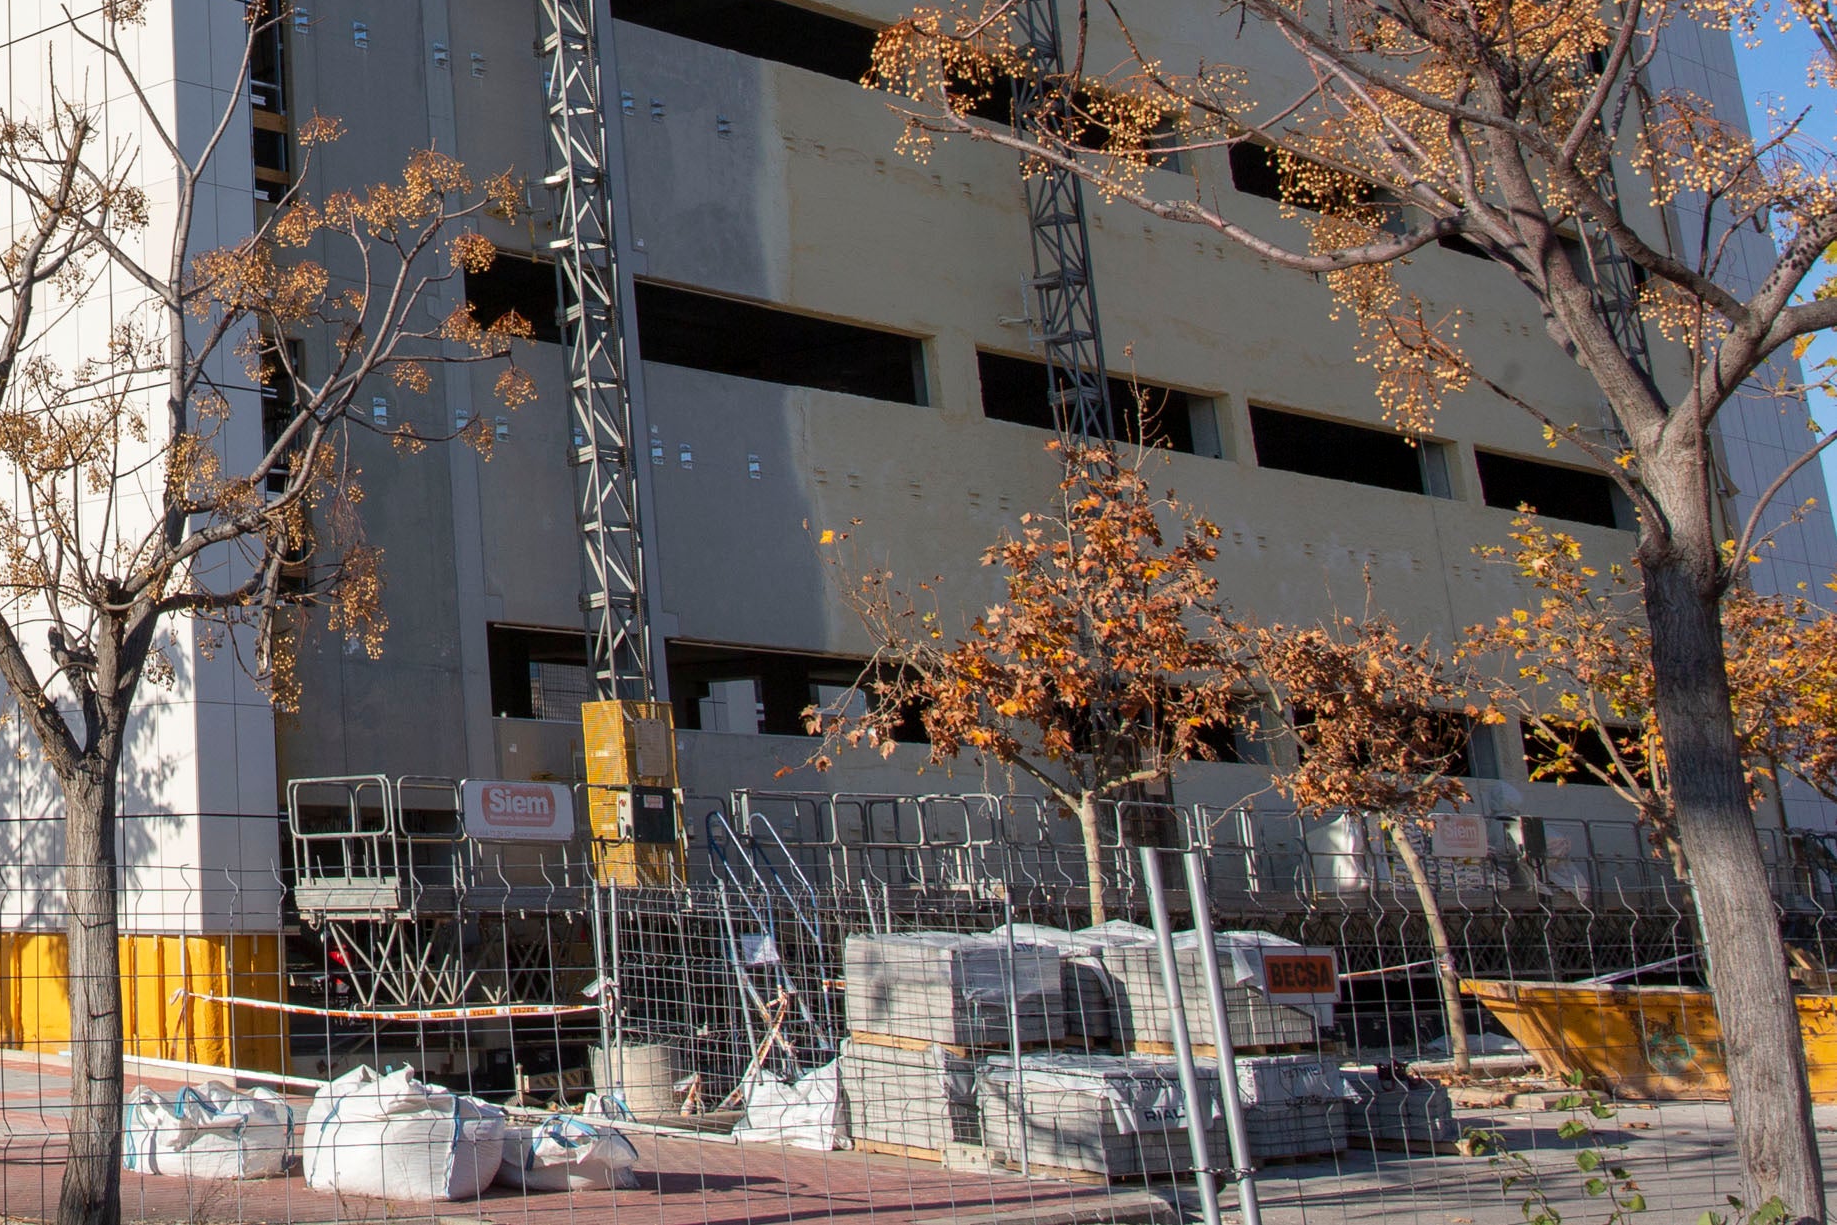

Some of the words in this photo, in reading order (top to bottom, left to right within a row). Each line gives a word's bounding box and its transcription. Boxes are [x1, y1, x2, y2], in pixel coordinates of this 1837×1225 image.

[489, 788, 549, 814] Siem
[1443, 824, 1477, 839] Siem
[1270, 961, 1332, 989] BECSA
[1143, 1108, 1186, 1122] RIAL
